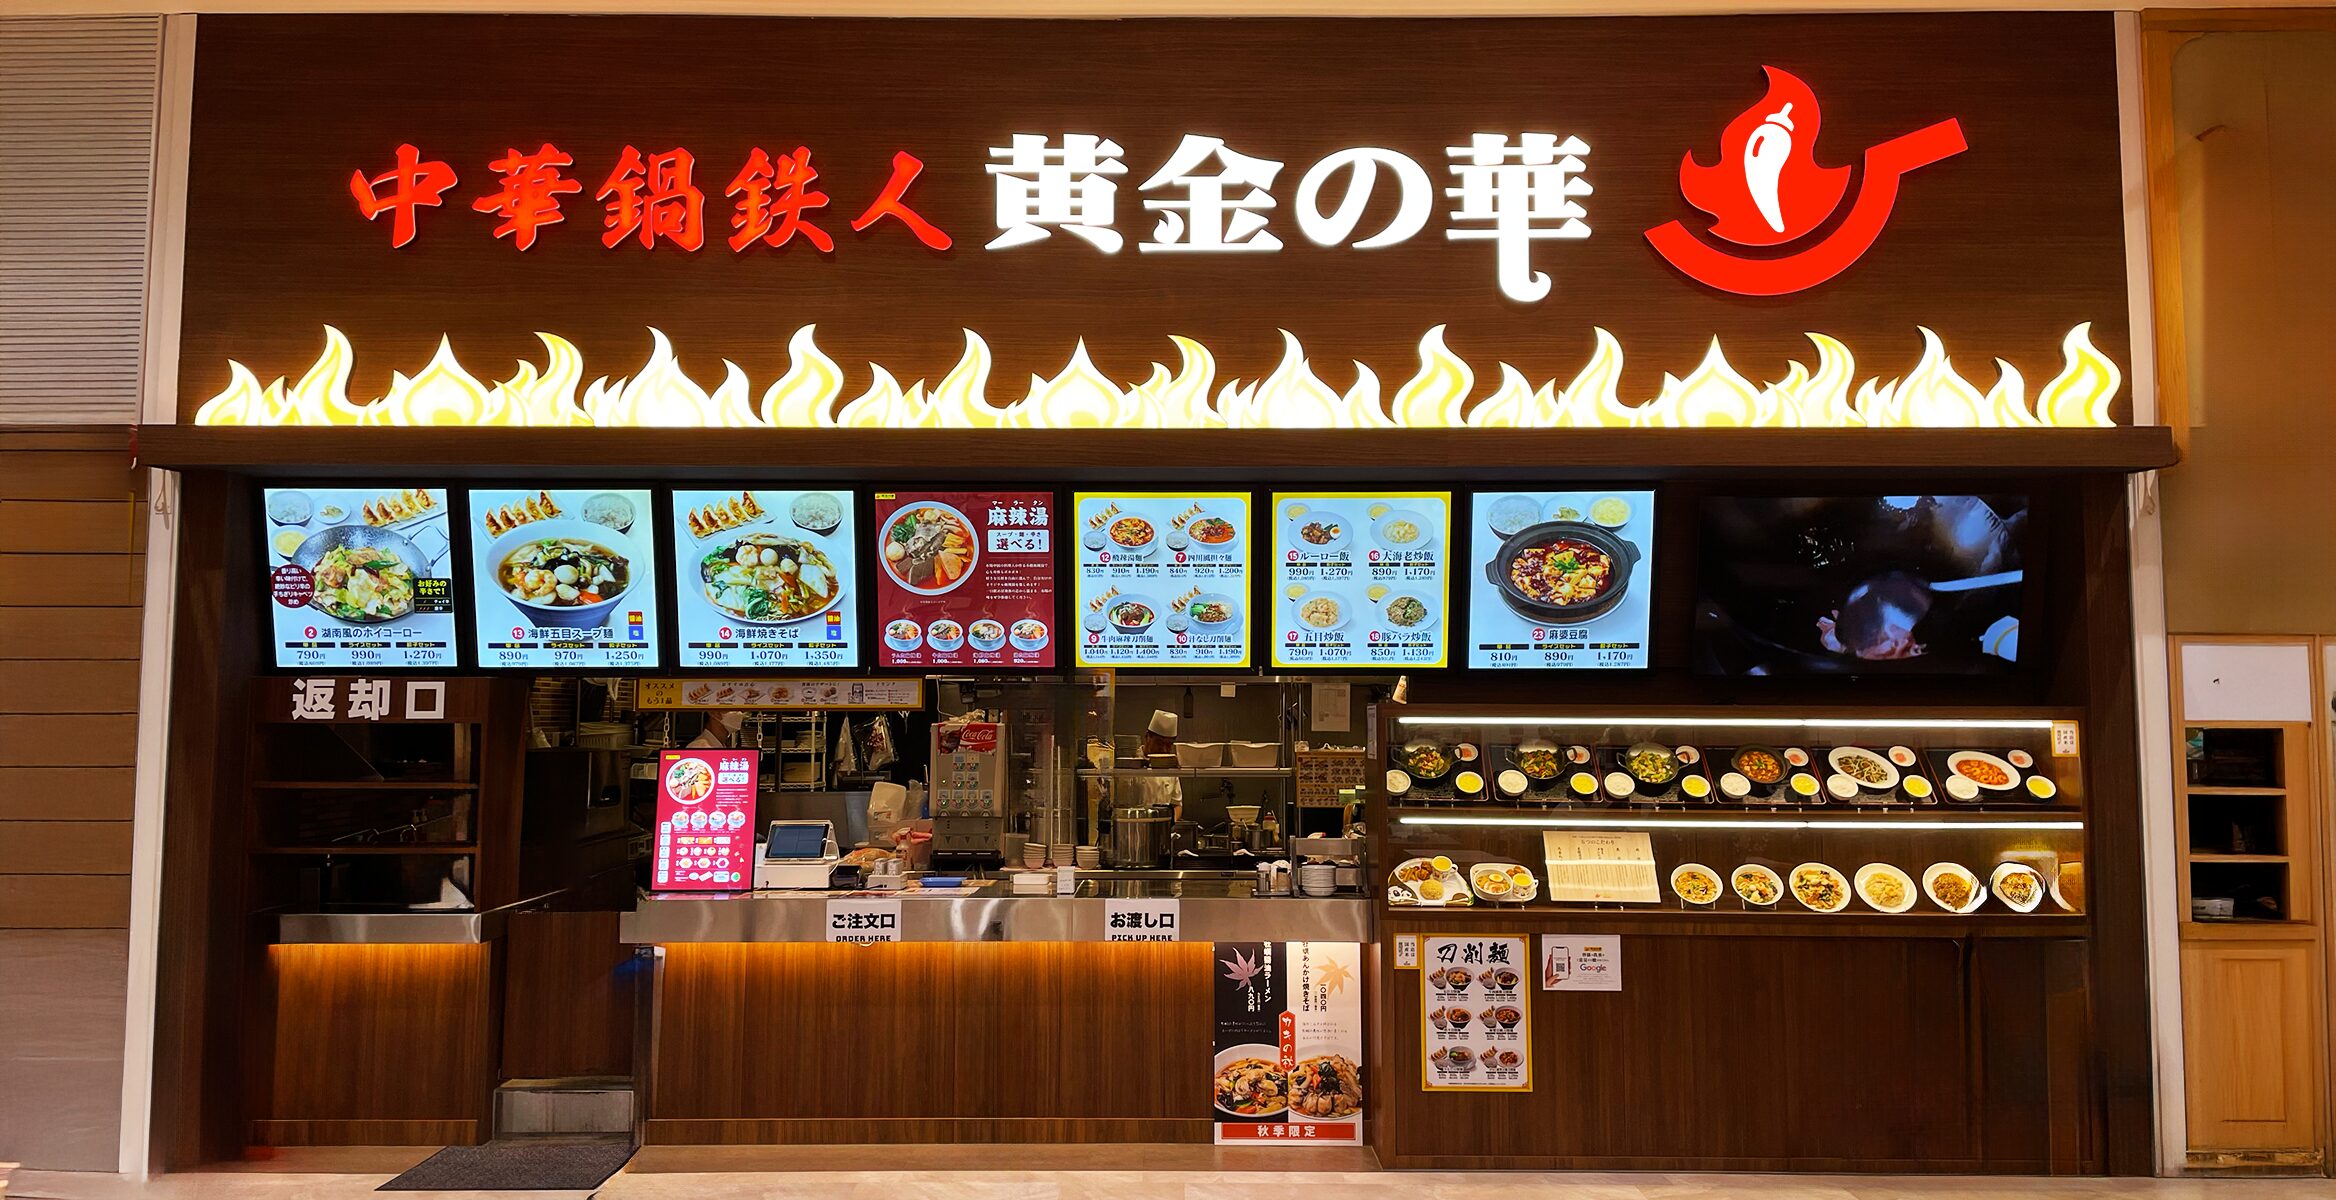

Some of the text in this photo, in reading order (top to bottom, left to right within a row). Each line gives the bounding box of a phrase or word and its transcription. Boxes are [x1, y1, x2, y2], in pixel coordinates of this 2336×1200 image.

[351, 131, 1595, 304] 中華鍋鉄人 黄金の華
[987, 506, 1049, 526] 麻辣湯
[996, 538, 1042, 550] 選べる!
[1300, 552, 1349, 561] ルーロー飯
[1383, 551, 1434, 561] 大海老炒飯
[321, 628, 422, 638] 湖南風のホイコーロー
[528, 628, 614, 639] 海鮮五目スープ麺
[735, 628, 799, 639] 海鮮焼きそば
[1305, 632, 1344, 642] 五目炒飯
[1382, 632, 1431, 641] 豚バラ炒飯
[1549, 630, 1588, 640] 麻婆豆腐
[296, 650, 442, 660] 790円 990円 1,270円
[499, 651, 644, 660] 890円 970円 1,250円
[699, 651, 843, 660] 990円 1,070円 1,350円
[1490, 652, 1633, 661] 810円 890円 1,170円
[645, 682, 674, 690] オススメ
[291, 678, 445, 721] 返却口
[832, 913, 895, 929] ご注文口
[1110, 912, 1174, 928] お渡し口
[1437, 942, 1510, 964] 刀削麺
[1580, 963, 1606, 973] Google
[1281, 1016, 1293, 1067] カキの秋
[1257, 1125, 1316, 1137] 秋季限定
